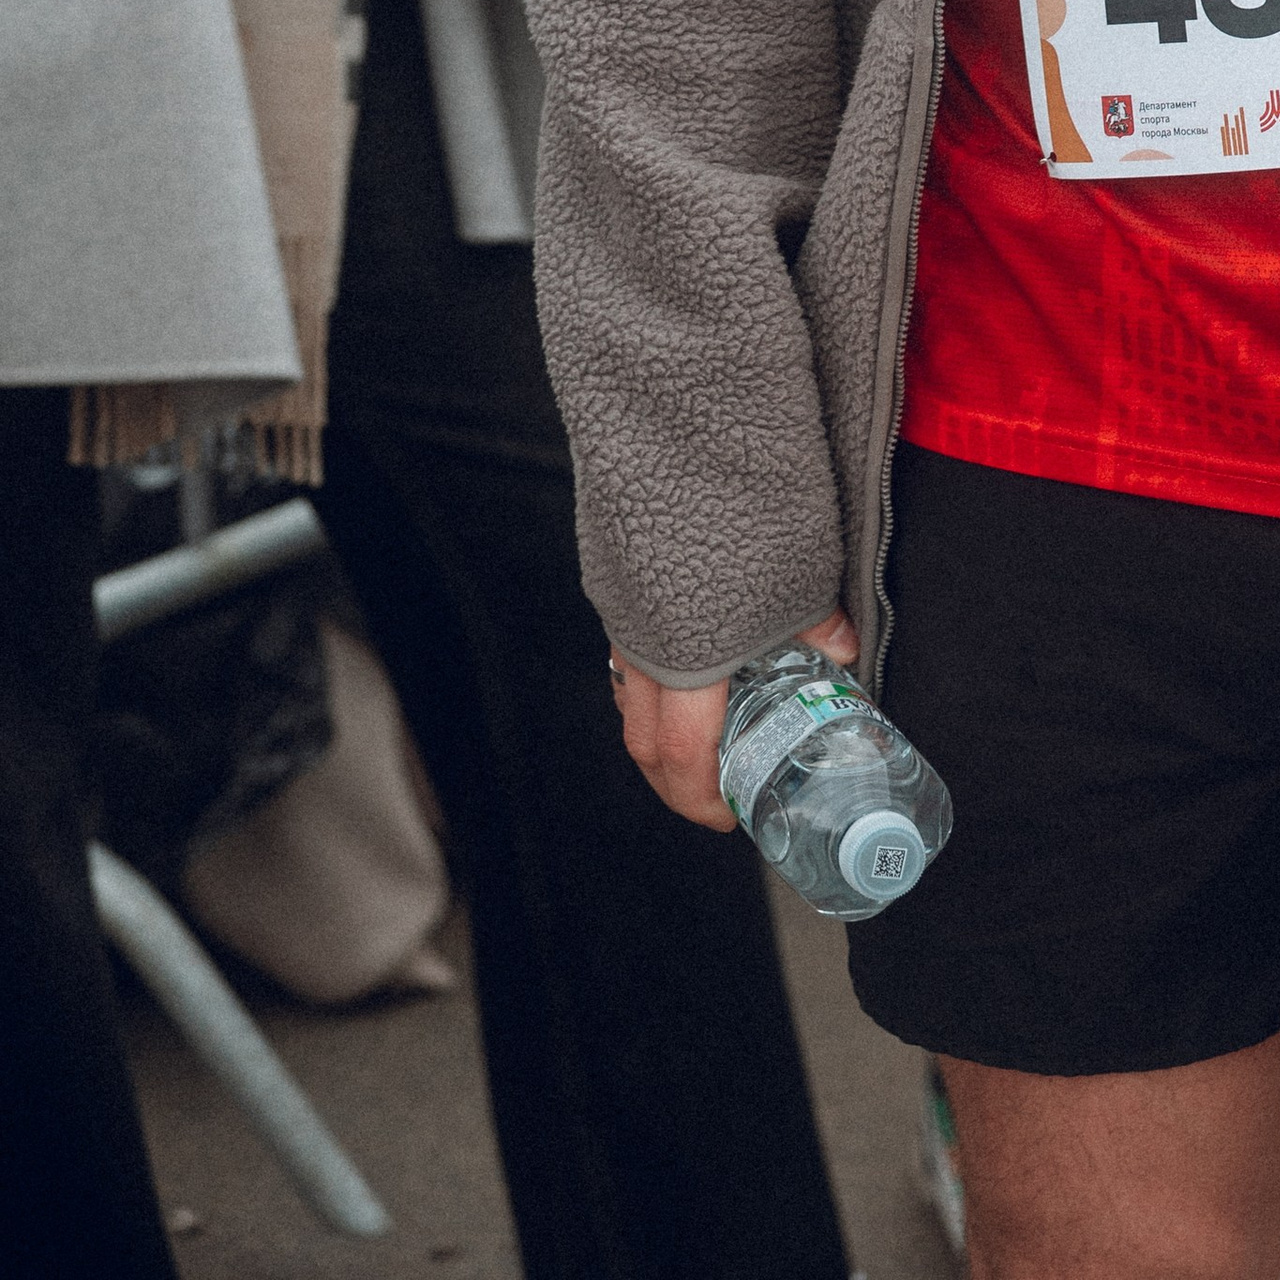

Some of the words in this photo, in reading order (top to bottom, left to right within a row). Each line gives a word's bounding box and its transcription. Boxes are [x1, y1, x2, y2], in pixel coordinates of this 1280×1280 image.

[1139, 100, 1198, 113] Департамент
[1140, 115, 1171, 126] спорта
[1141, 128, 1172, 139] города
[1173, 127, 1209, 137] Москвы
